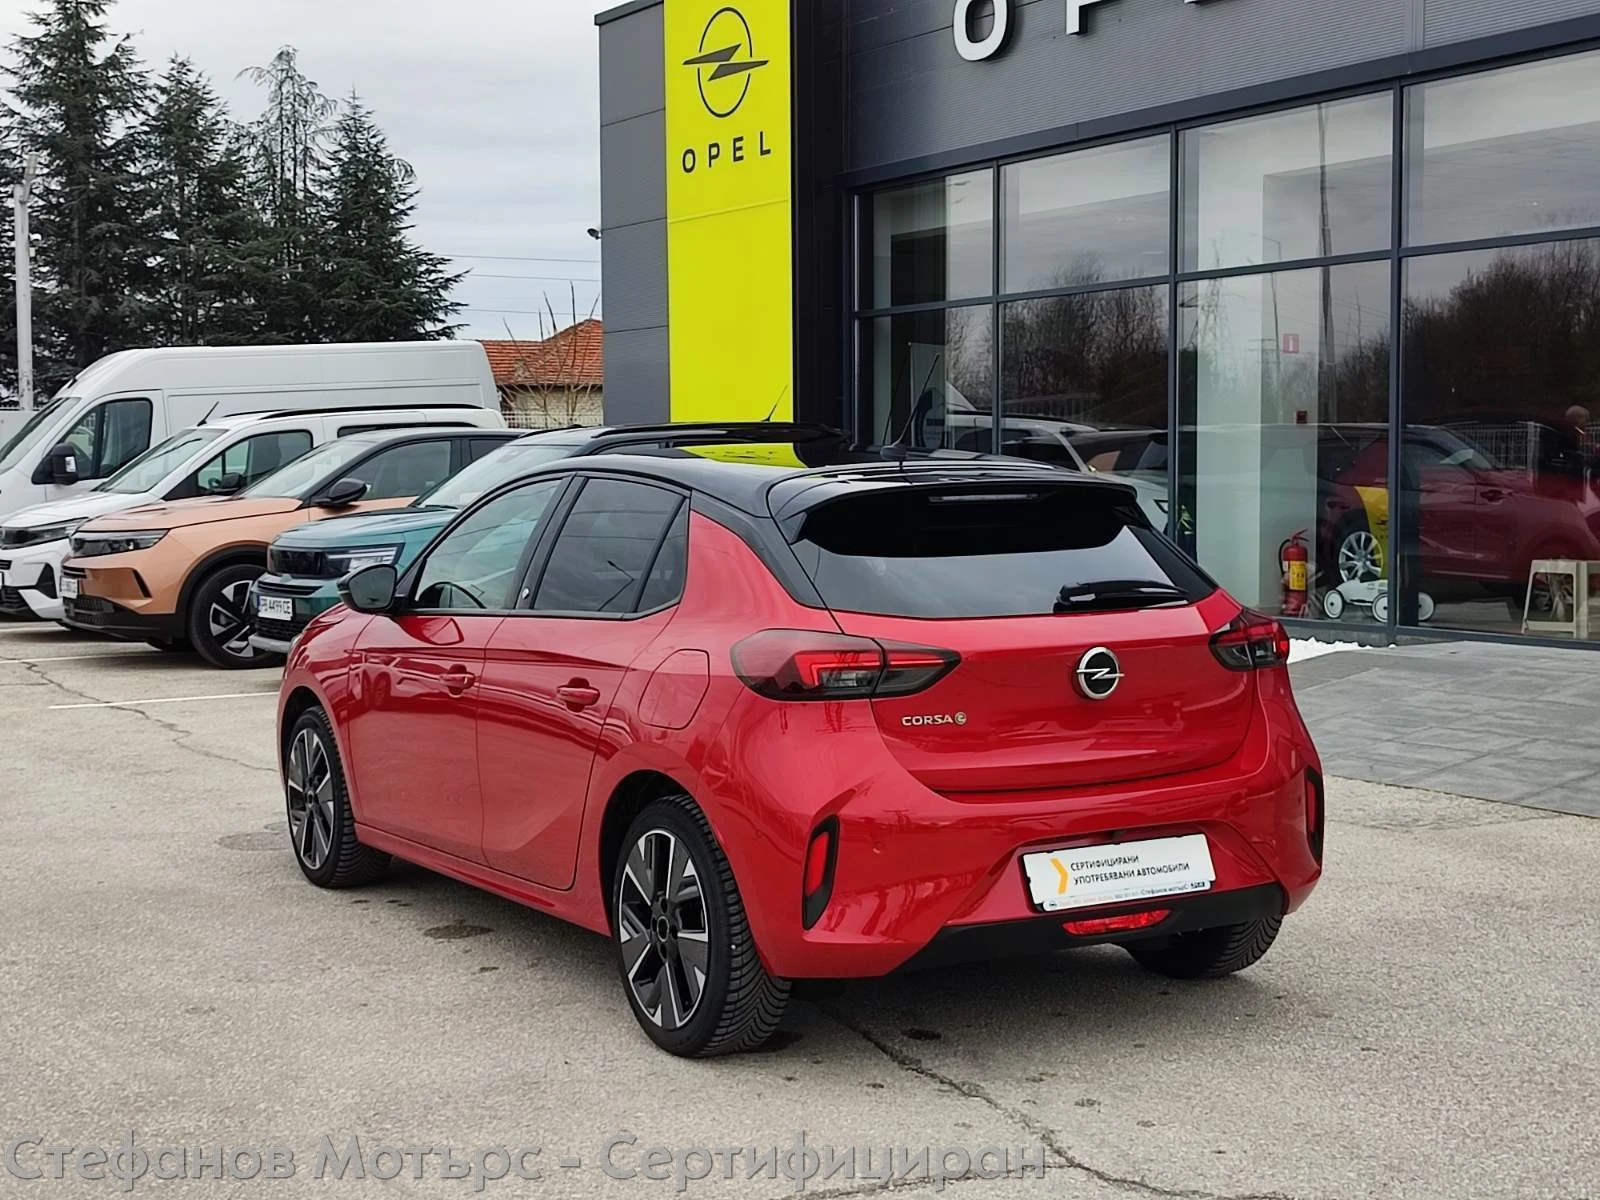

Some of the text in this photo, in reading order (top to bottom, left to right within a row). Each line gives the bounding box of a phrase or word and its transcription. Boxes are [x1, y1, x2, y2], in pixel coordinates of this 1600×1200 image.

[682, 131, 771, 173] OPEL
[901, 714, 954, 726] CORSA
[1070, 855, 1139, 872] СЕРТИФИЦИРАНИ
[1073, 862, 1190, 885] УПОТРЕБЯВАНИ АВТОМОБИЛИ
